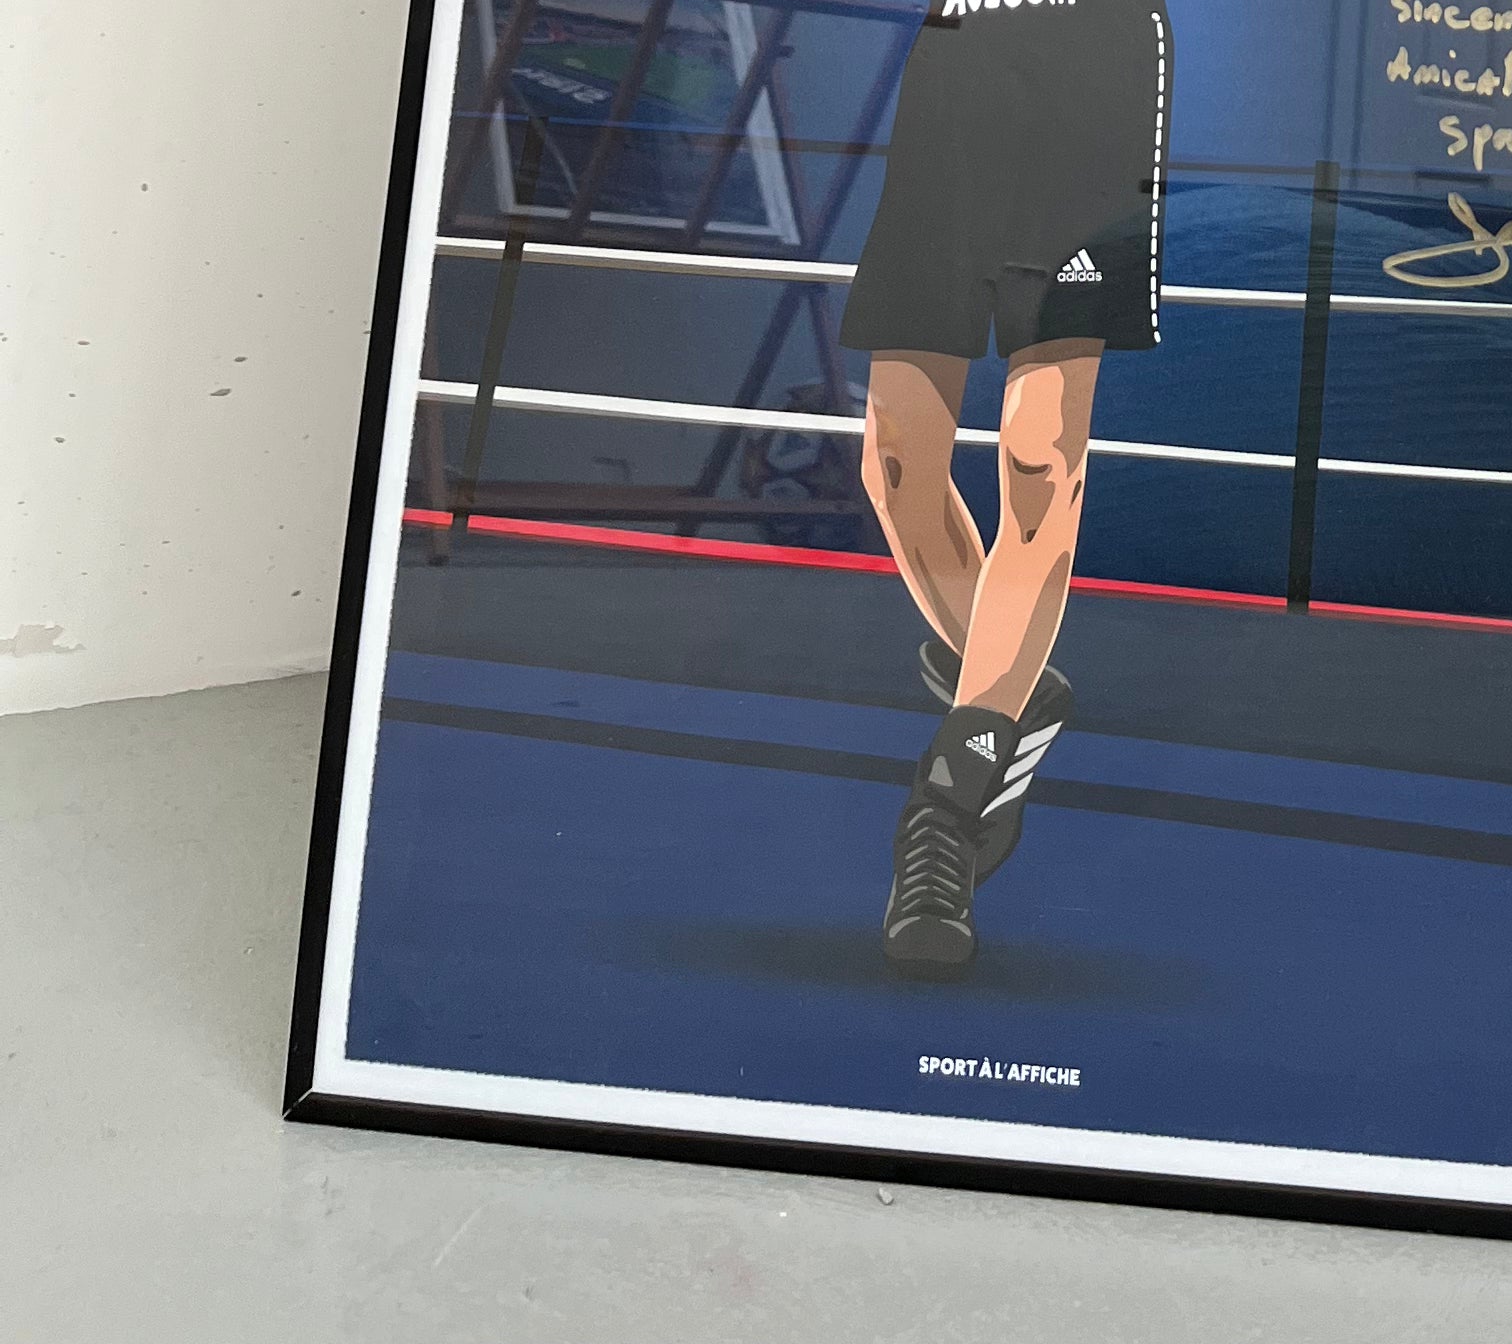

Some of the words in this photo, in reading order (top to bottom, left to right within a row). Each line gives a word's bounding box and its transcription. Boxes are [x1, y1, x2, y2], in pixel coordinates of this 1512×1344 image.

[1056, 268, 1103, 283] adidas
[918, 1055, 978, 1077] SPORT
[978, 1056, 993, 1079] À
[994, 1061, 1081, 1087] L'AFFICHE
